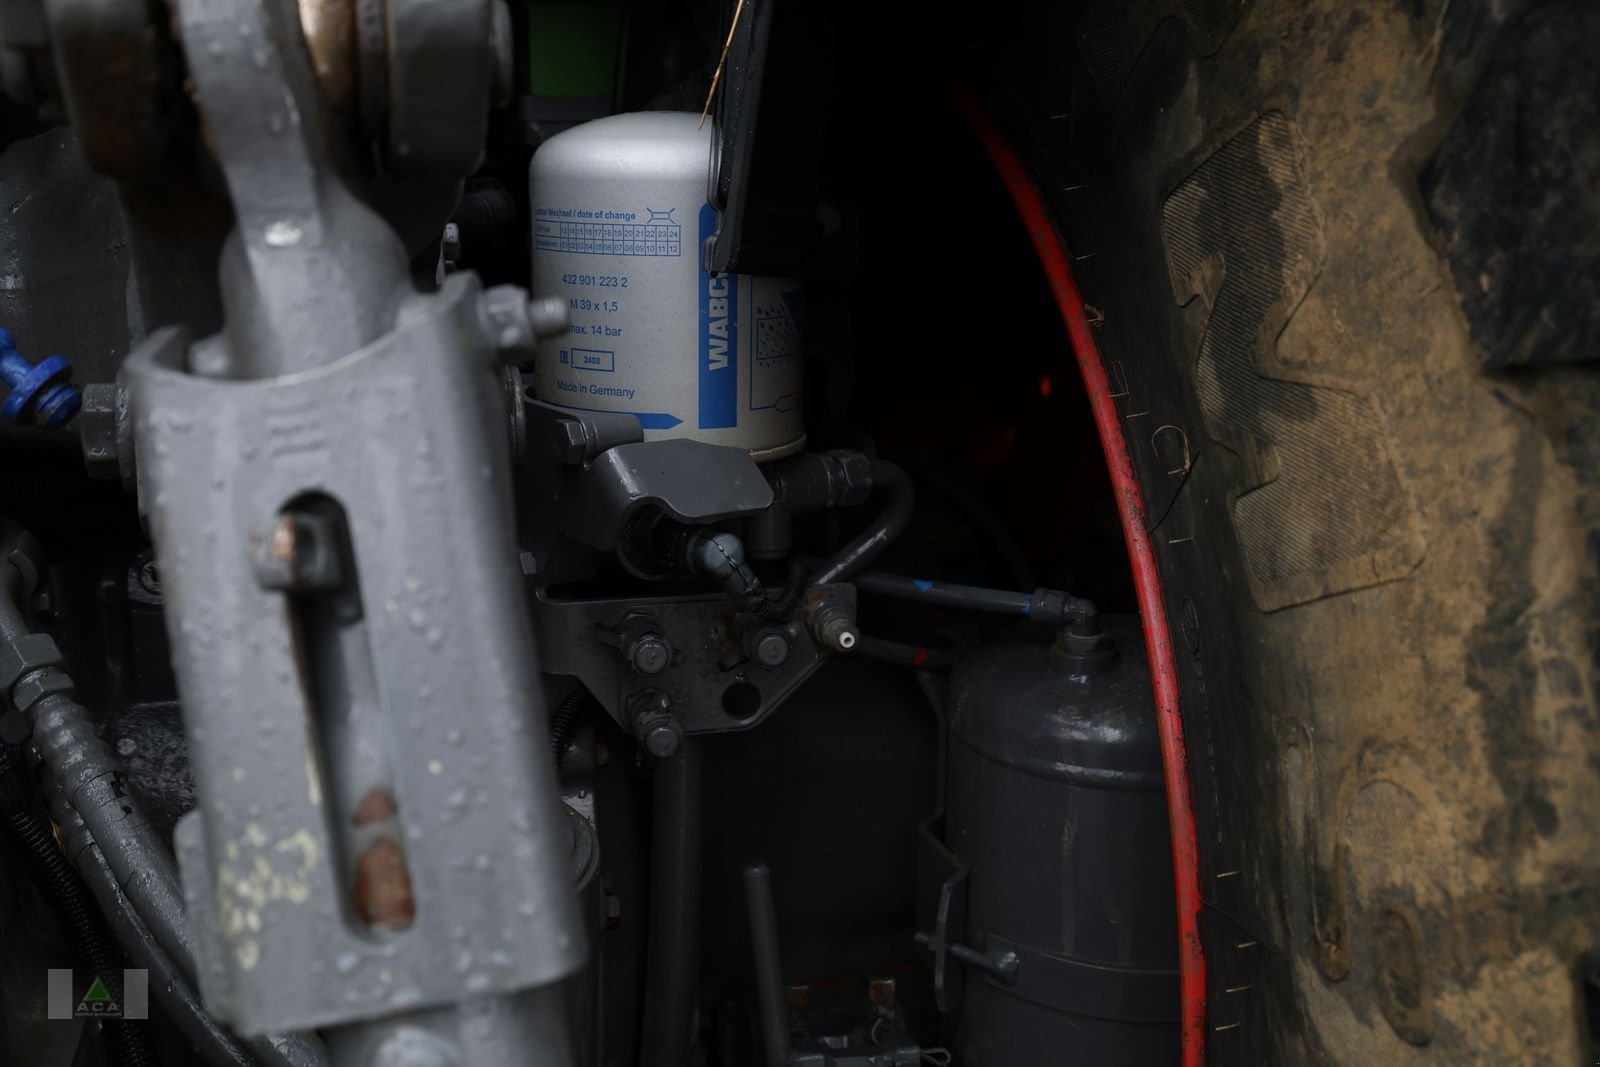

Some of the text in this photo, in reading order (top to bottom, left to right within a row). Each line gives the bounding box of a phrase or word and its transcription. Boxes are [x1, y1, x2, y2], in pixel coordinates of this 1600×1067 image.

[577, 210, 593, 218] date
[595, 210, 604, 219] of
[605, 211, 636, 222] change
[594, 229, 602, 237] 17
[624, 230, 633, 238] 20
[636, 230, 644, 238] 21
[646, 230, 655, 238] 22
[658, 230, 667, 238] 23
[669, 230, 678, 238] 24
[614, 243, 622, 251] 07
[636, 244, 644, 252] 09
[646, 244, 655, 252] 10
[658, 244, 666, 252] 11
[562, 273, 628, 288] 432 901 223 2
[570, 299, 619, 312] M 39 x 1,5
[708, 272, 729, 371] WABC
[591, 325, 602, 335] 14
[605, 325, 622, 337] bar
[557, 380, 636, 400] Made in Germany
